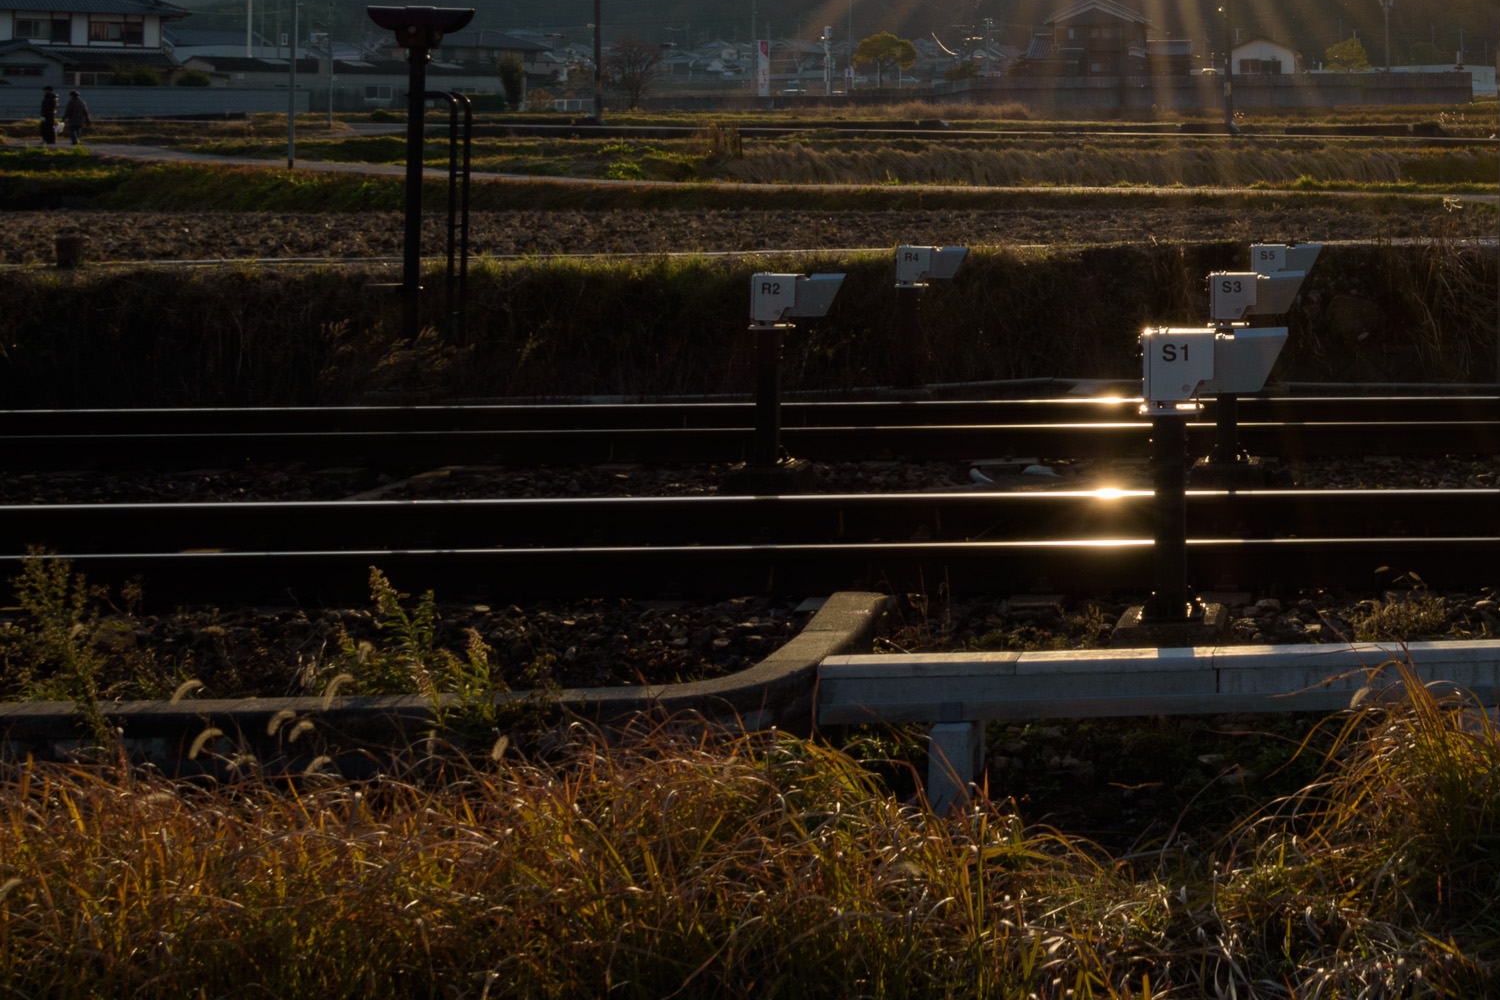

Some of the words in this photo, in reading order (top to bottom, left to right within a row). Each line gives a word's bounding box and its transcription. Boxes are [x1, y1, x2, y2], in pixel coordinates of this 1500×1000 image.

[904, 252, 919, 262] R4
[1260, 250, 1275, 260] S5
[761, 282, 781, 295] R2
[1222, 280, 1242, 293] S3
[1161, 343, 1189, 362] S1
